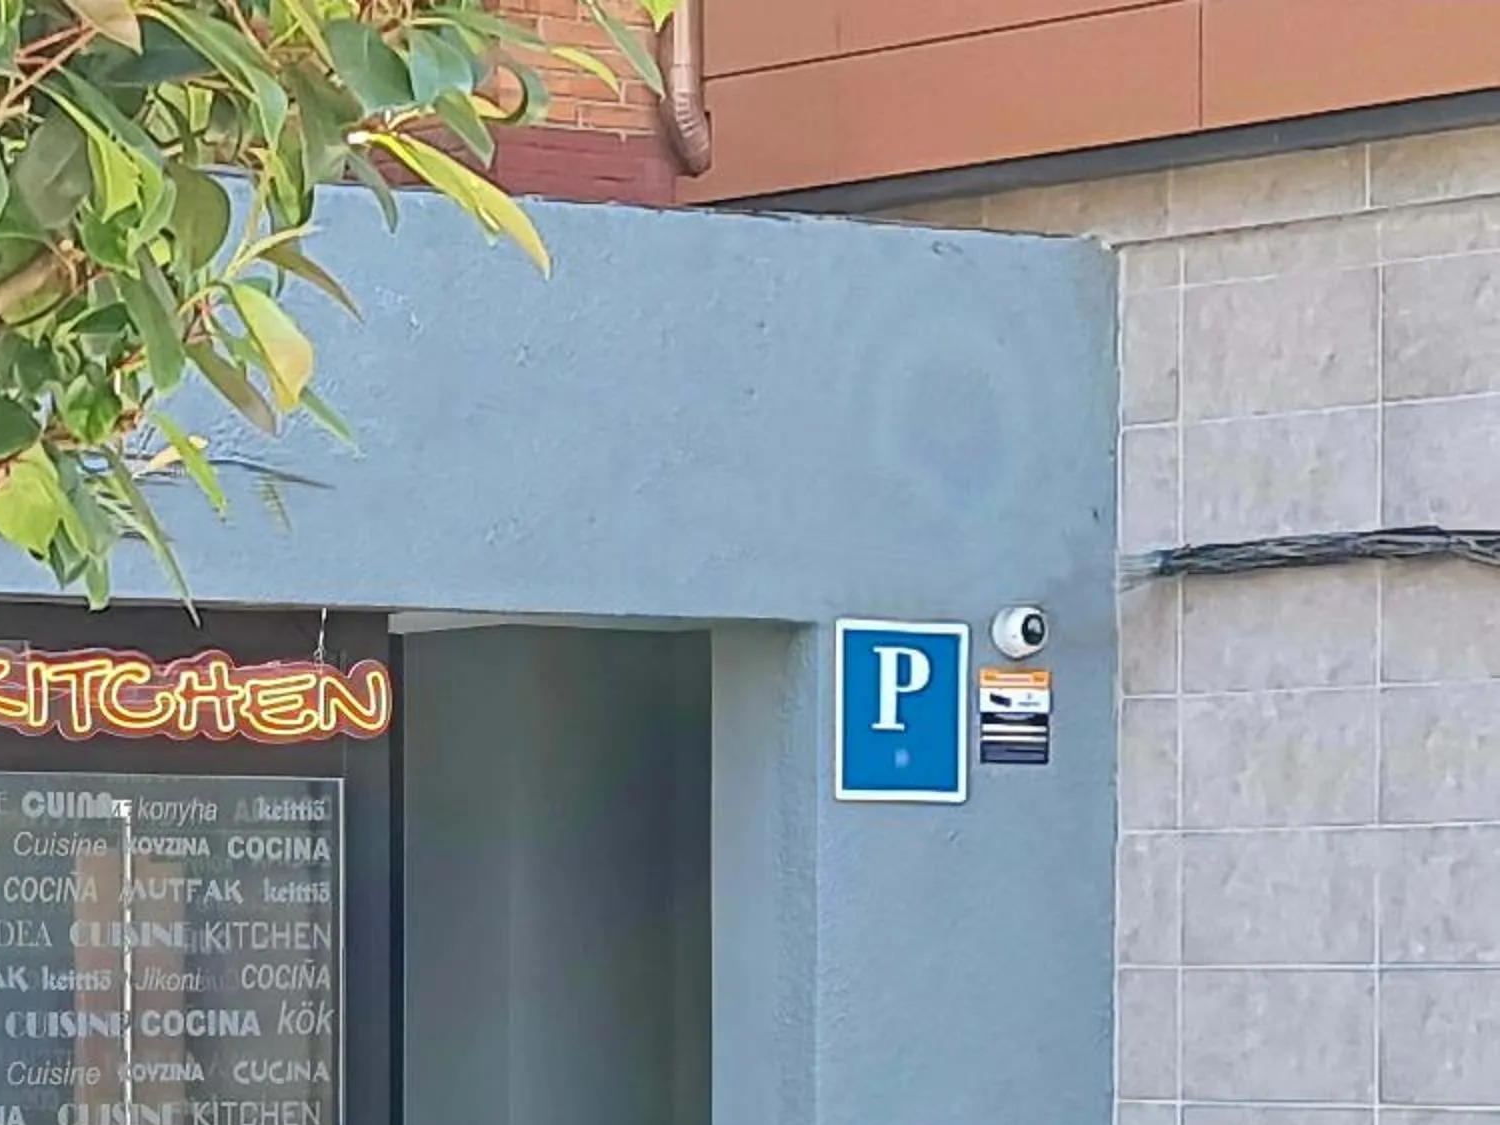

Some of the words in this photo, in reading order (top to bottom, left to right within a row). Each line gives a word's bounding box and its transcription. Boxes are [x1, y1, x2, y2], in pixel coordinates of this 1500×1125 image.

[871, 647, 930, 731] P
[137, 796, 219, 827] konyha
[13, 831, 107, 858] Cuisine
[227, 835, 331, 862] COCINA
[203, 920, 332, 951] KITCHEN
[140, 1009, 262, 1038] COCINA
[277, 1000, 335, 1036] kök
[7, 1061, 101, 1087] Cuisine
[232, 1061, 331, 1086] CUCINA
